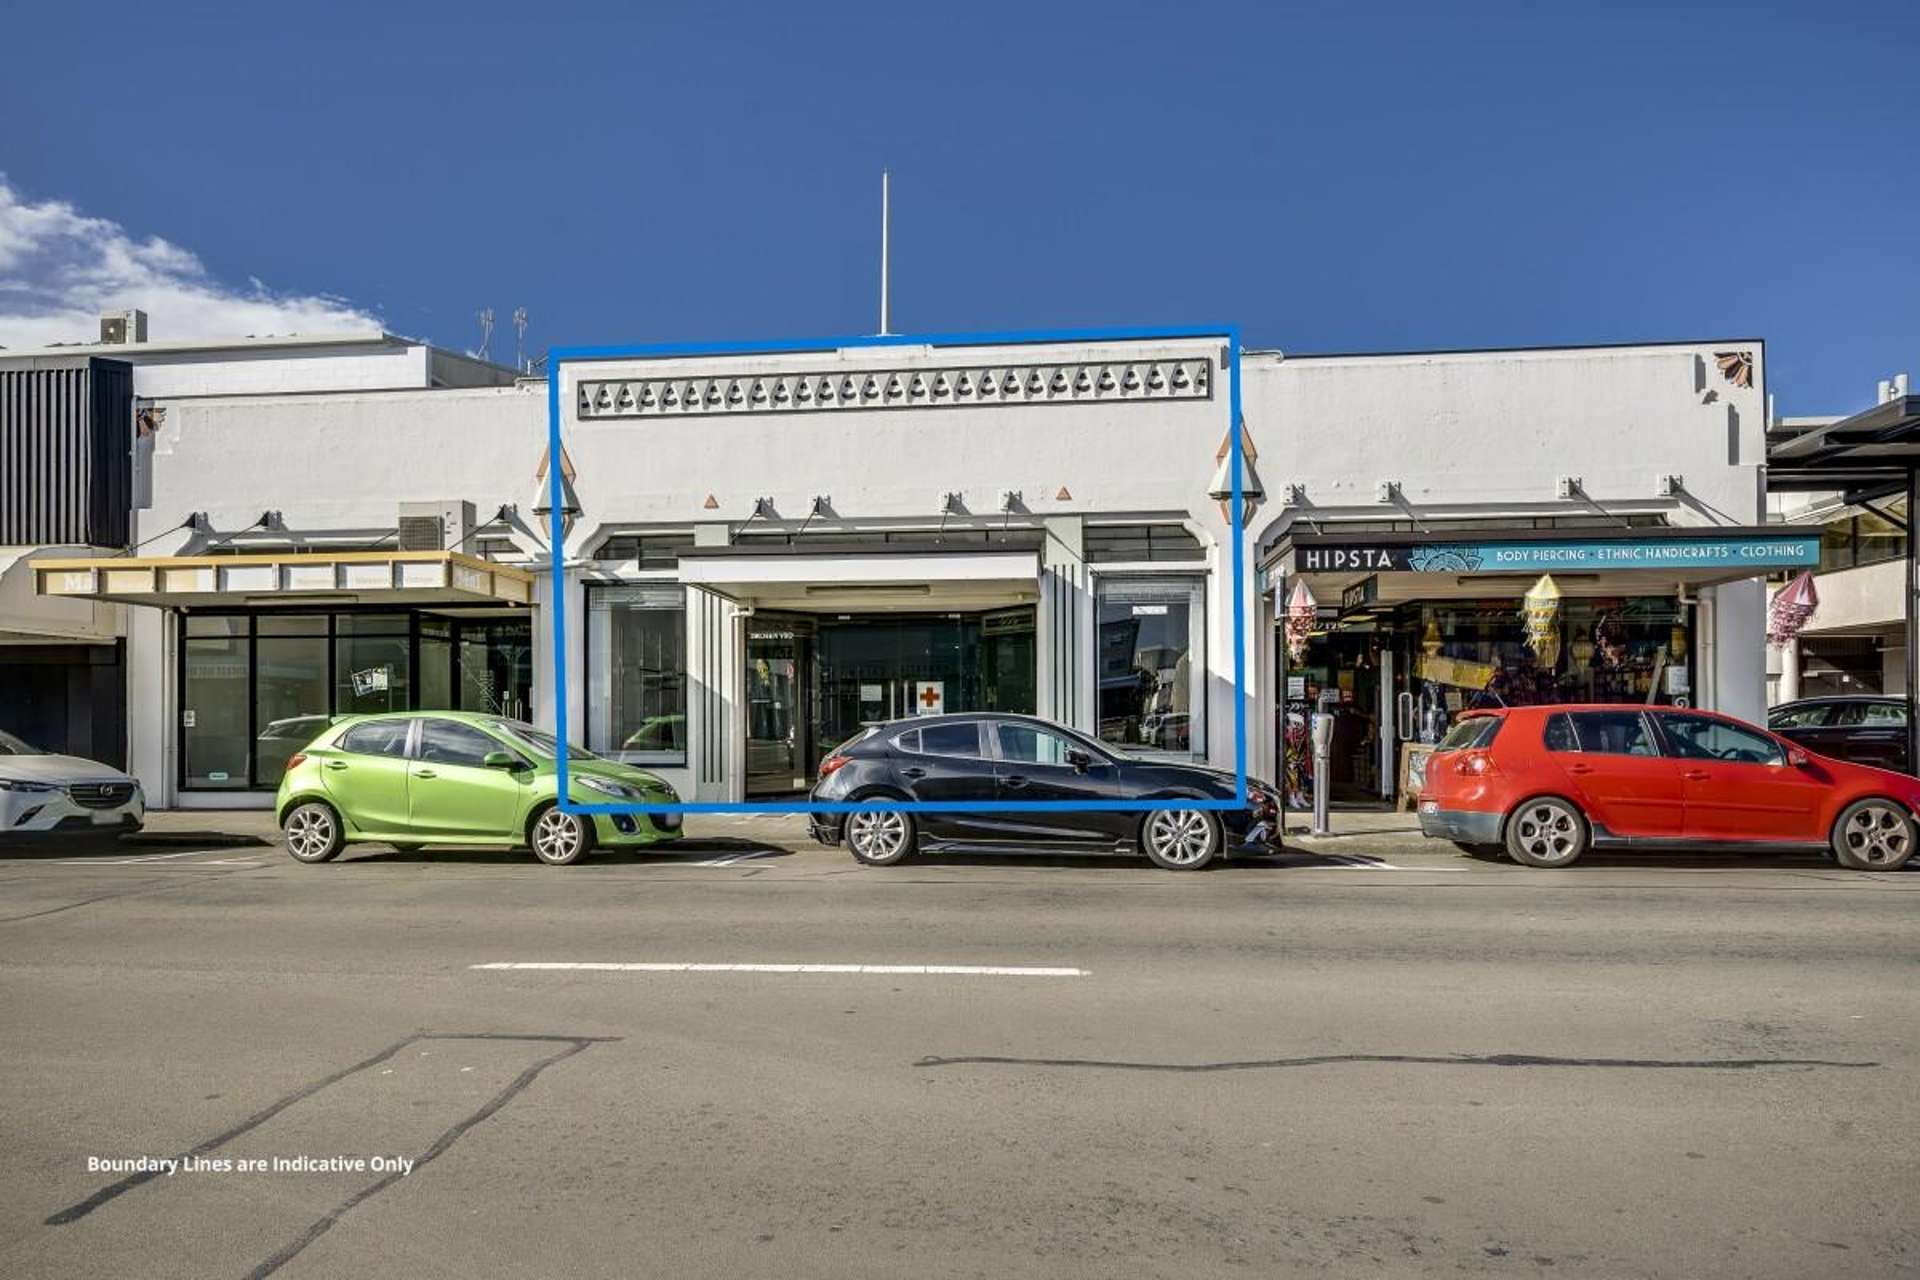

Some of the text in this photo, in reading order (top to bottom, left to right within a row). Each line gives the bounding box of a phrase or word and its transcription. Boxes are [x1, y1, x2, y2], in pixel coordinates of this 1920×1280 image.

[1306, 549, 1393, 569] HIPSTA
[1496, 545, 1804, 562] BODY PIERCING ETHNIC HANDICRAFTS CLOTHING
